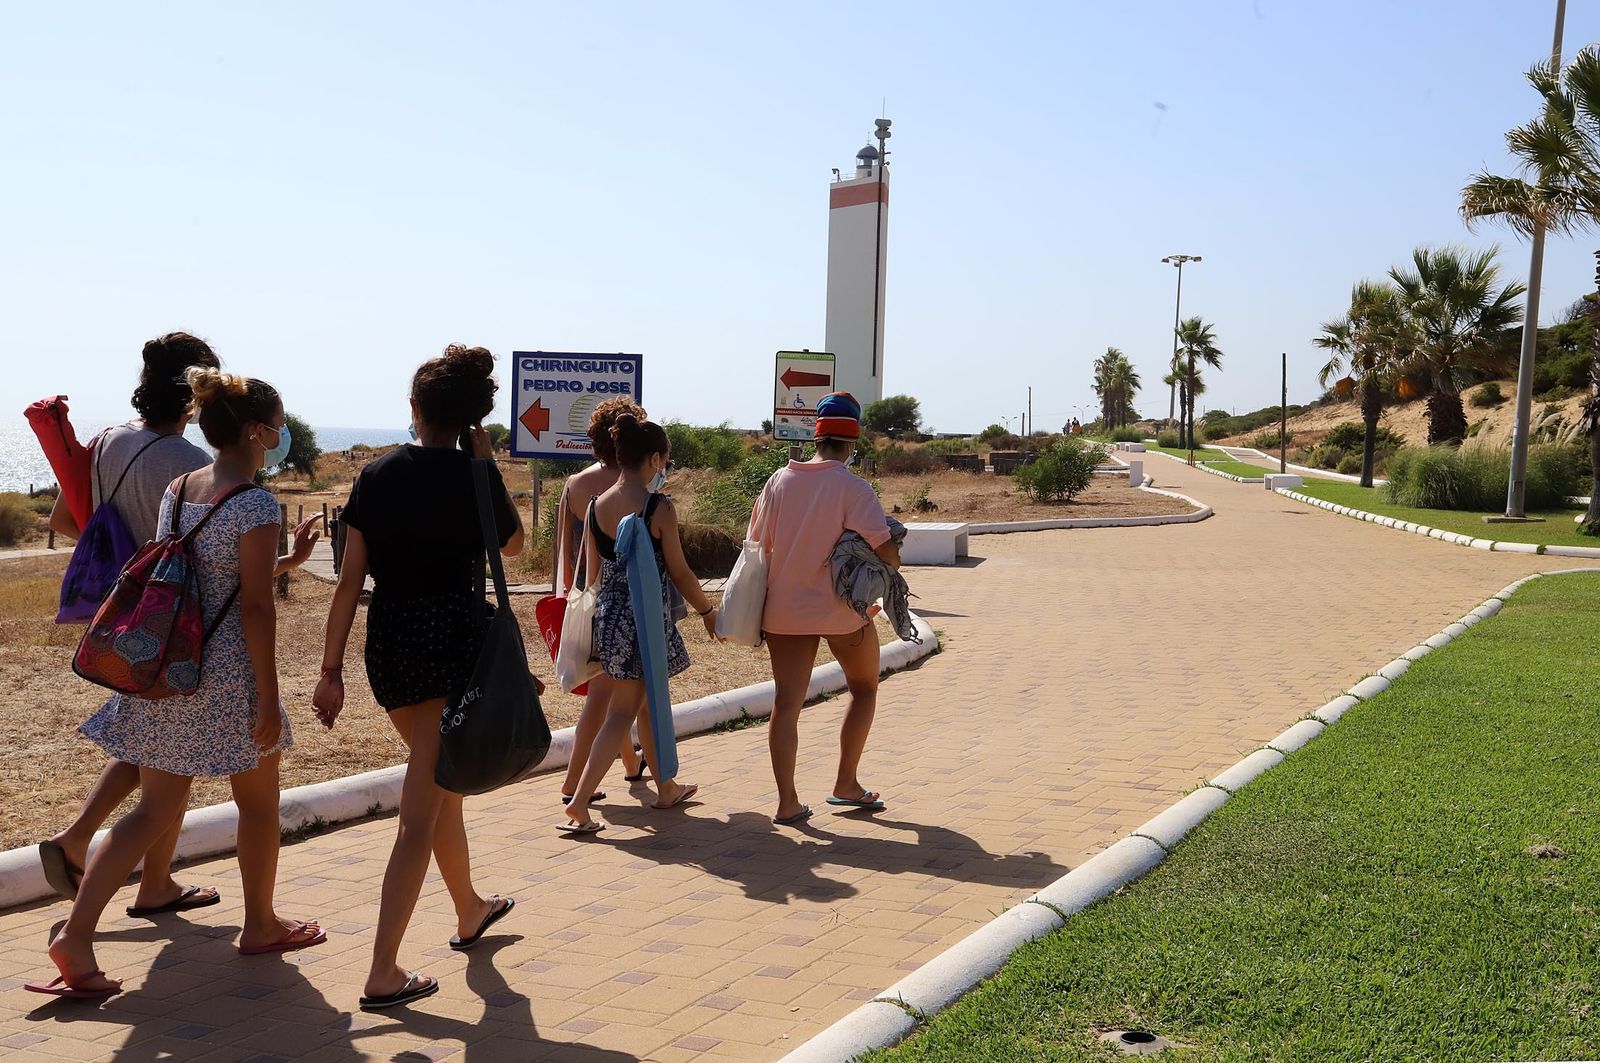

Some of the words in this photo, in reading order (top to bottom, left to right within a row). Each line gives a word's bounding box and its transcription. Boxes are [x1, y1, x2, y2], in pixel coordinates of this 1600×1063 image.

[521, 359, 635, 375] CHIRINGUITO
[523, 379, 584, 393] PEDRO
[586, 381, 632, 395] JOSE
